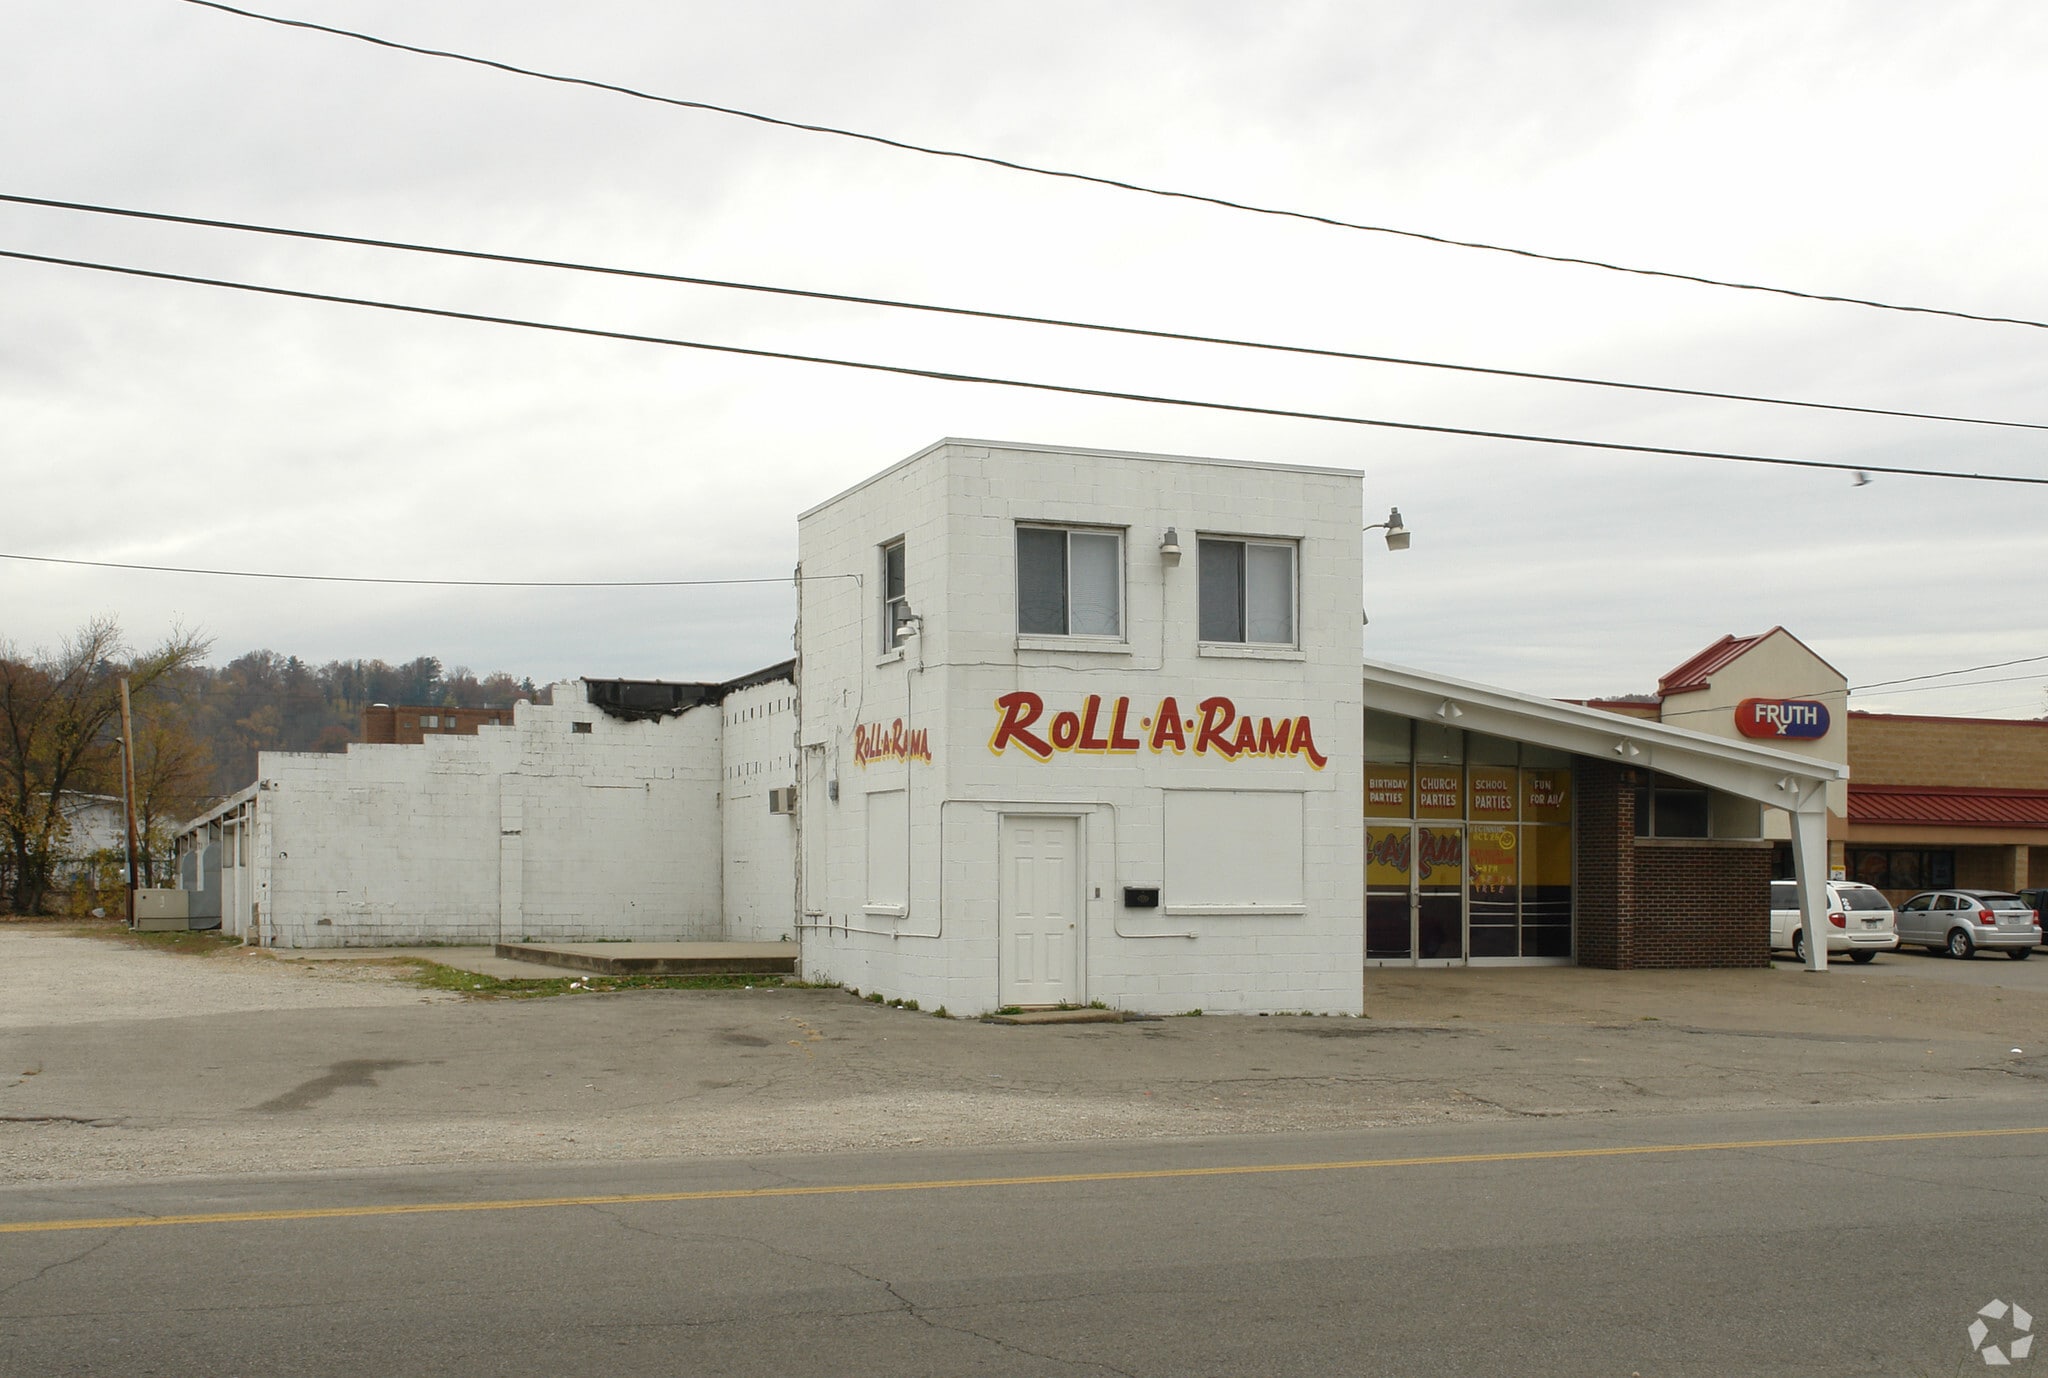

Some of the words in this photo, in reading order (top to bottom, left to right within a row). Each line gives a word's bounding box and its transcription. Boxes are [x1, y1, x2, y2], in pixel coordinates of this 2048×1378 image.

[1755, 703, 1817, 726] FRUTH
[1369, 779, 1408, 791] BIRTHDAY
[1420, 777, 1457, 792] CHURCH
[1475, 779, 1508, 791] SCHOOL
[1534, 780, 1552, 791] FUN
[1369, 792, 1403, 805] PARTIES
[1420, 793, 1457, 808] PARTIES
[1475, 795, 1512, 811] PARTIES
[1530, 794, 1545, 805] FOR
